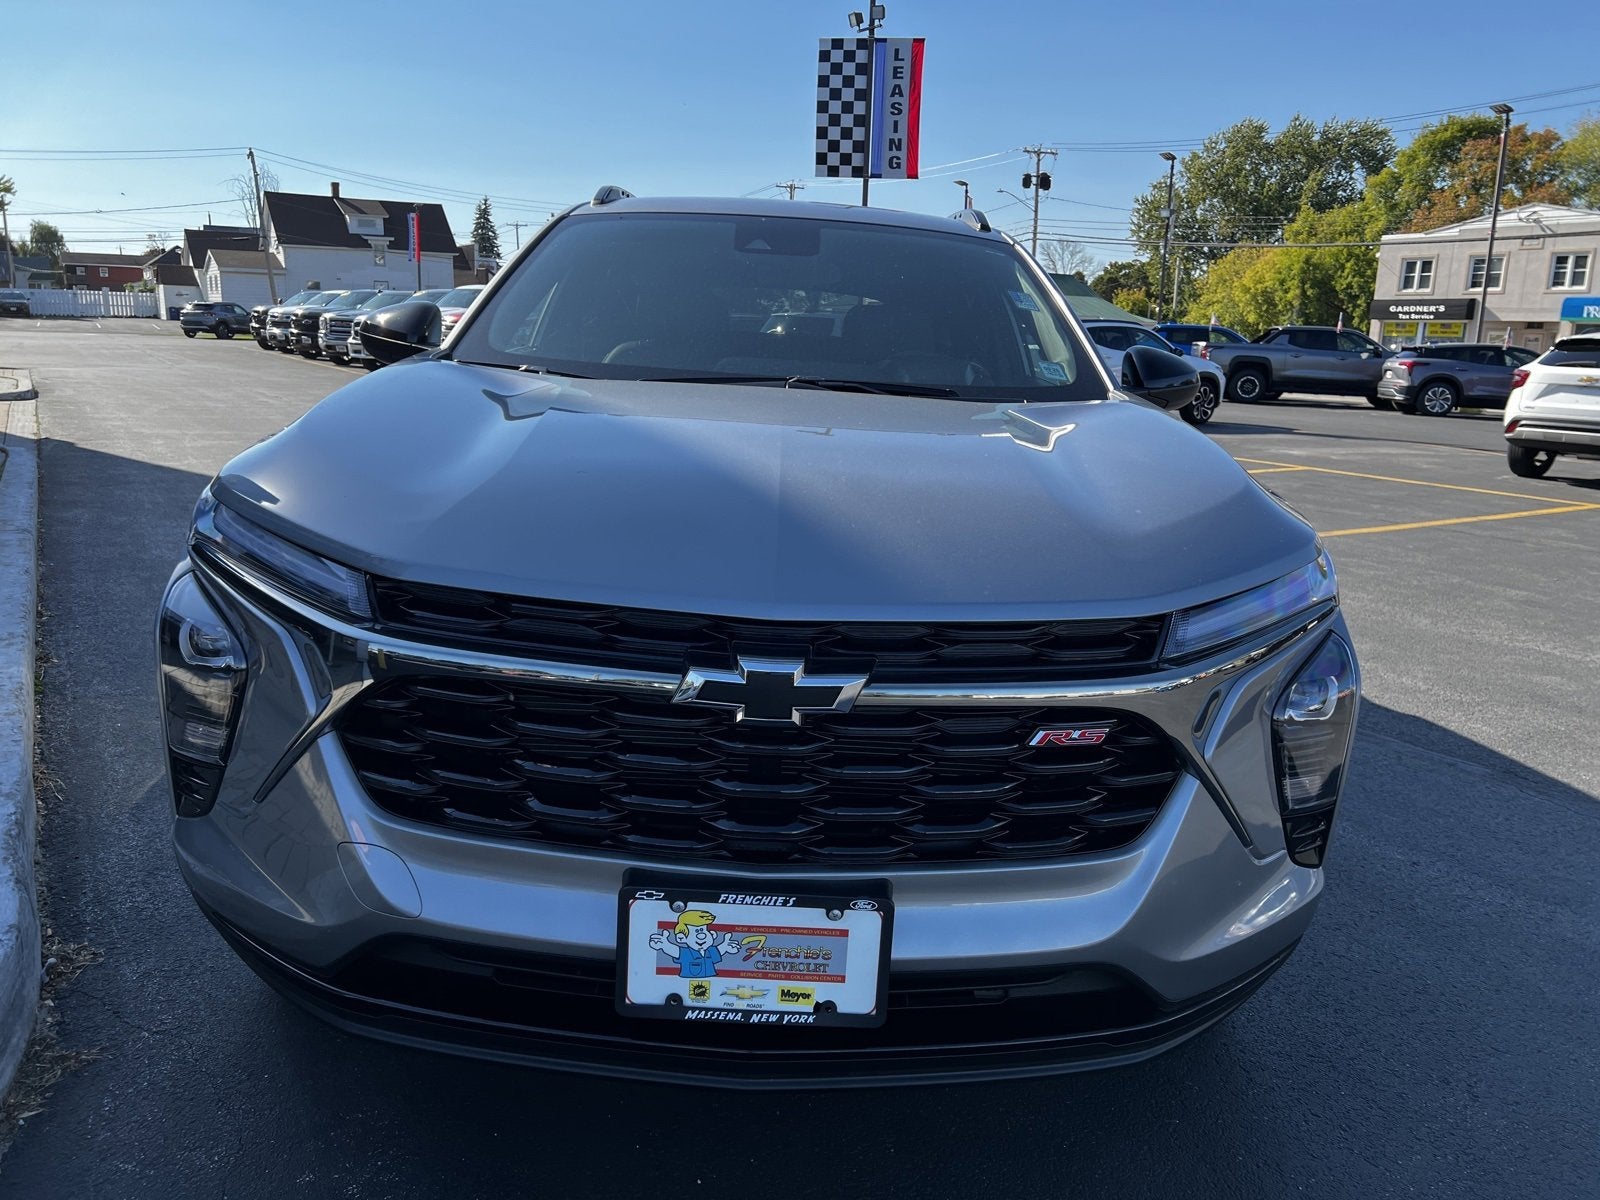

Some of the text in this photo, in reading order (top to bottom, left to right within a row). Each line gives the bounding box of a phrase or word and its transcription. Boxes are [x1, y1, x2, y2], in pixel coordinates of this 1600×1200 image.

[888, 48, 904, 169] LEASING
[1389, 304, 1445, 312] GARDNER'S
[1029, 728, 1110, 746] RS
[718, 893, 797, 907] FRENCHIE'S
[855, 900, 872, 910] Ford
[741, 935, 832, 962] Frenchie's
[754, 960, 829, 973] CHEVROLET
[780, 988, 812, 1002] Meyer
[750, 1013, 780, 1023] NEW
[782, 1014, 817, 1025] YORK
